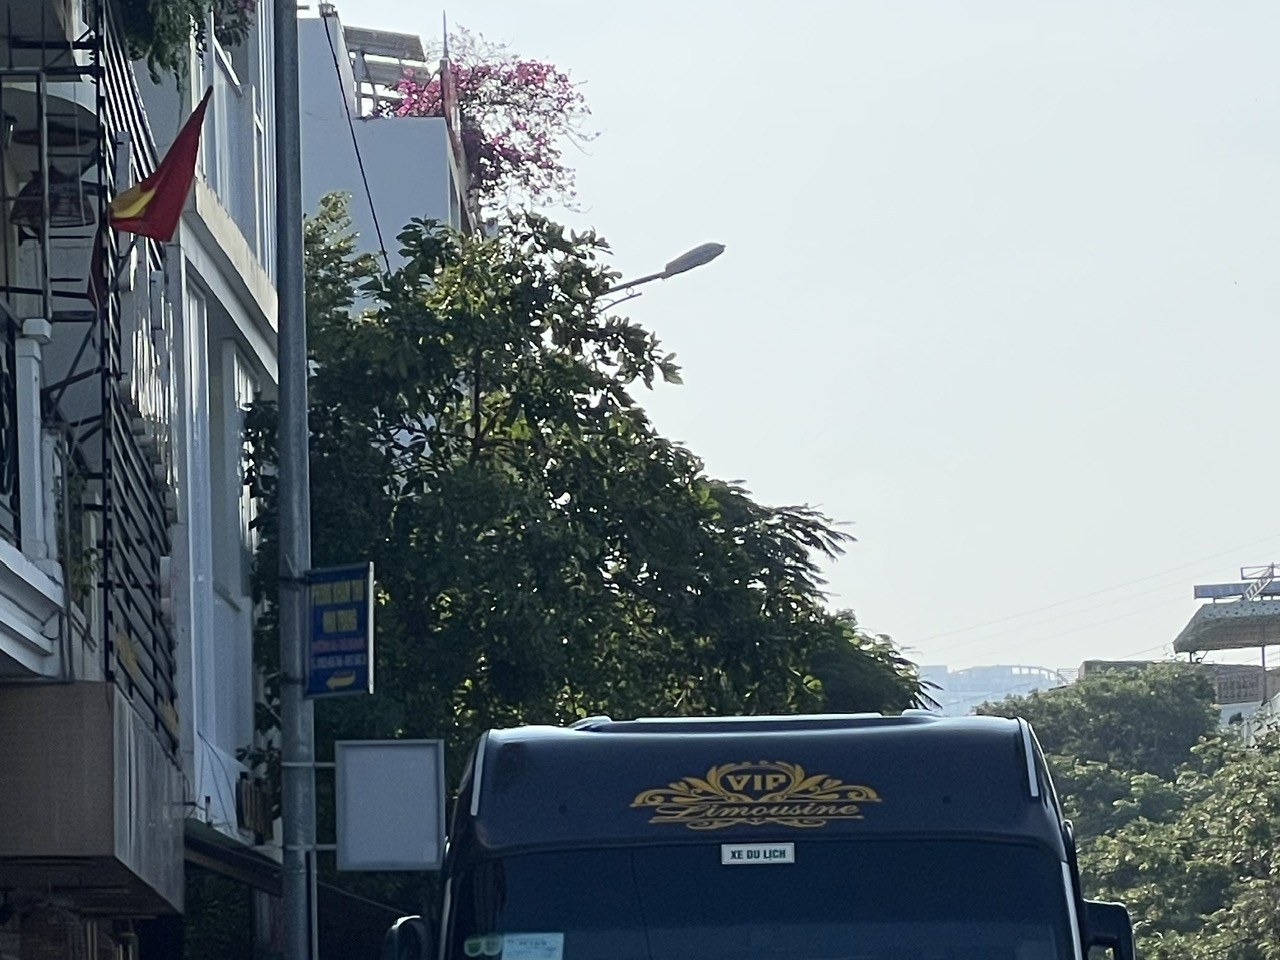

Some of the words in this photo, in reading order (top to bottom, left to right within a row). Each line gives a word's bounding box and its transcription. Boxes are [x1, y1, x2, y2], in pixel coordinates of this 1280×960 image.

[726, 774, 787, 791] VIP
[655, 801, 861, 819] Limousine
[730, 849, 744, 860] XE
[746, 849, 761, 860] DU
[763, 849, 786, 862] LỊCH
